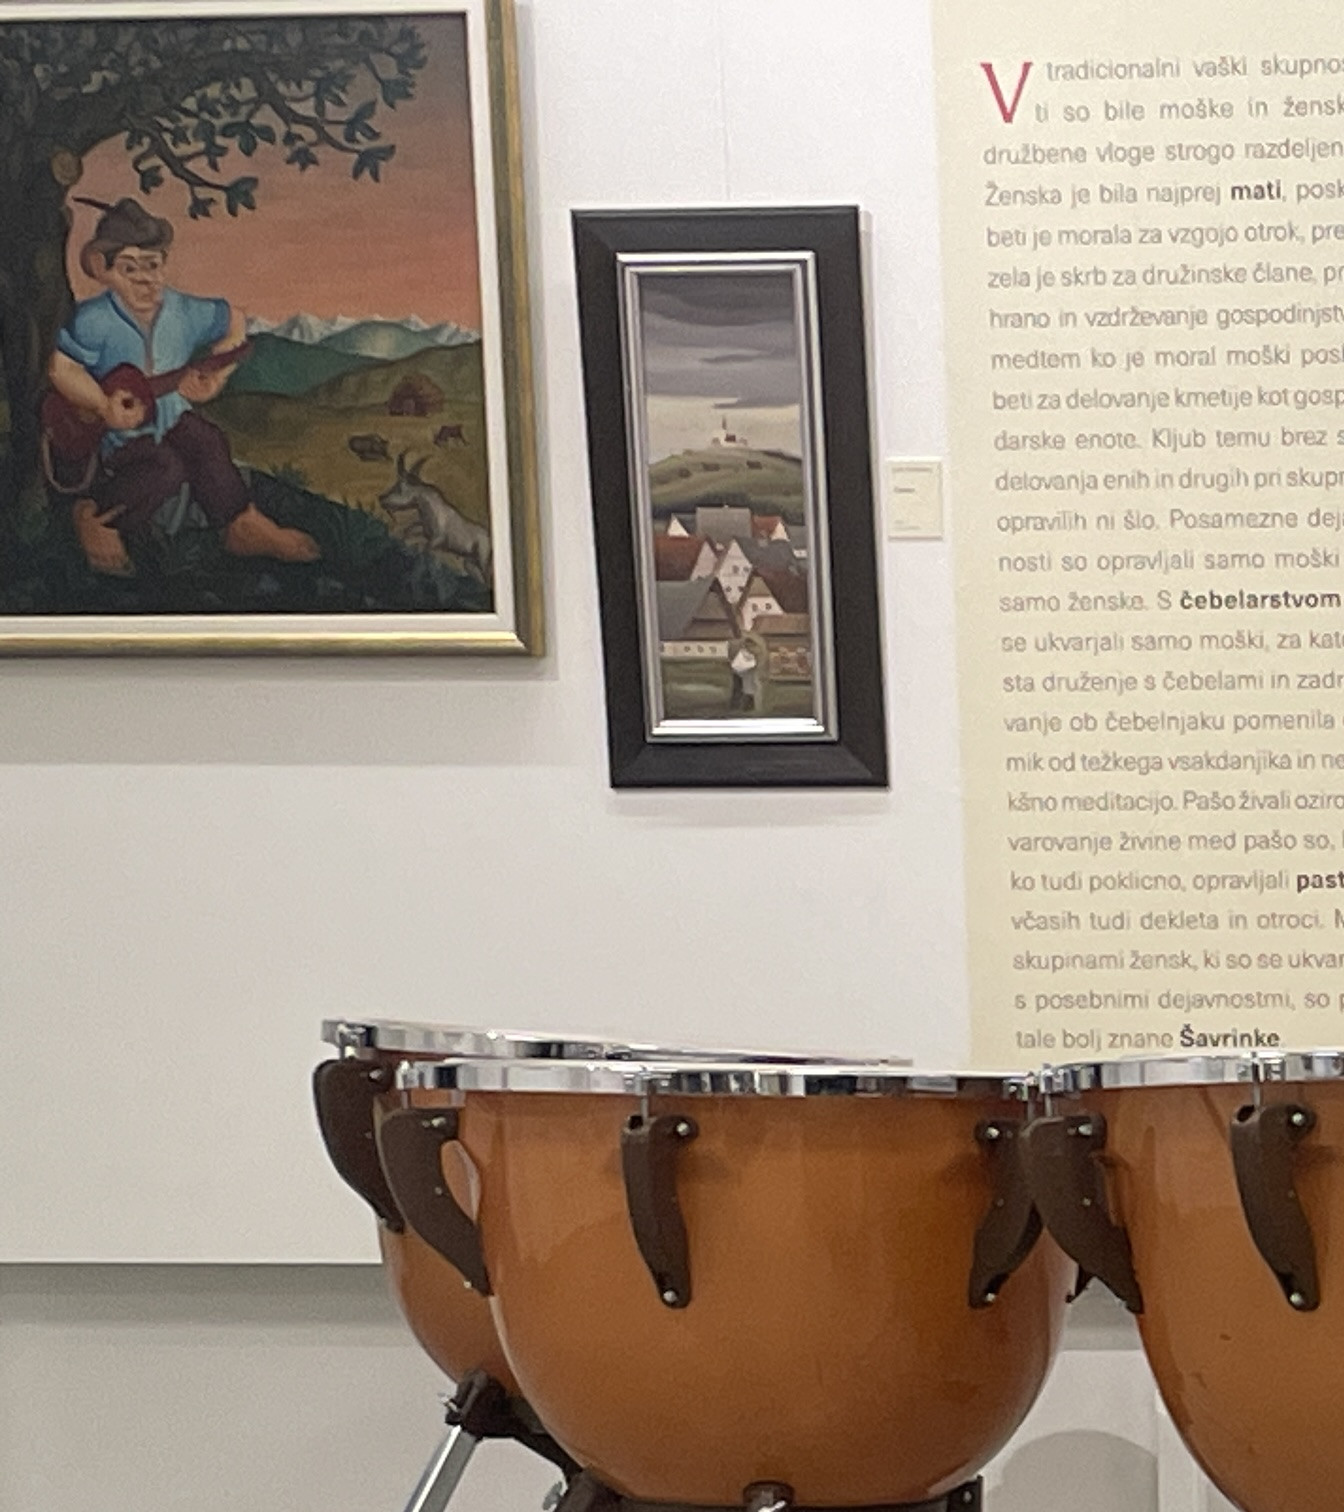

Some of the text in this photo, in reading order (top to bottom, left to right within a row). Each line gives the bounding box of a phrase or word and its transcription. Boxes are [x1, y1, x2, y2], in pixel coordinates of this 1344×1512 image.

[980, 62, 1033, 123] V
[1044, 58, 1180, 81] tradicionalni
[1192, 56, 1249, 78] vaški
[1063, 105, 1090, 122] so
[1104, 99, 1145, 122] bile
[1160, 97, 1234, 120] moške
[1247, 96, 1271, 118] in
[983, 141, 1235, 167] družbene vloge strogo
[985, 180, 1062, 207] Ženska
[1071, 184, 1090, 210] je
[1099, 183, 1138, 204] bila
[1146, 186, 1226, 207] najprej
[1058, 225, 1132, 246] morala
[1136, 227, 1162, 245] za
[1167, 225, 1239, 248] vzgojo
[988, 267, 1030, 289] zela
[1061, 265, 1107, 287] skrb
[1142, 263, 1247, 285] družinske
[989, 310, 1051, 329] hrano
[1058, 309, 1077, 328] in
[1084, 305, 1208, 330] vzdrževanje
[1090, 347, 1117, 369] ko
[1154, 347, 1216, 367] moral
[1226, 343, 1290, 366] moški
[1065, 388, 1170, 412] delovanje
[1174, 387, 1253, 410] kmetije
[1257, 386, 1288, 407] kot
[994, 430, 1066, 451] darske
[1152, 427, 1207, 452] Kljub
[1216, 430, 1271, 448] temu
[1281, 427, 1328, 446] brez
[995, 471, 1098, 494] delovanja
[1103, 470, 1150, 490] enih
[1155, 469, 1174, 489] in
[1178, 467, 1249, 493] drugih
[1169, 508, 1298, 529] Posamezne
[999, 554, 1052, 572] nosti
[1061, 556, 1087, 572] so
[1097, 550, 1194, 575] opravljali
[1204, 553, 1265, 570] samo
[1275, 547, 1339, 569] moški
[999, 596, 1060, 612] samo
[1156, 590, 1173, 610] S
[1179, 589, 1341, 610] čebelarstvom
[1131, 634, 1192, 651] samo
[1277, 633, 1301, 650] za
[1003, 675, 1035, 692] sta
[1042, 670, 1138, 695] druženje
[1162, 671, 1264, 690] čebelami
[1271, 674, 1290, 689] in
[1004, 716, 1062, 736] vanje
[1069, 713, 1098, 732] ob
[1105, 711, 1225, 734] čebelnjaku
[1233, 711, 1335, 732] pomenila
[1006, 752, 1044, 772] mik
[1048, 752, 1076, 772] od
[1080, 751, 1164, 775] težkega
[1167, 750, 1292, 771] vsakdanjika
[1297, 750, 1316, 769] in
[1008, 792, 1058, 812] kšno
[1183, 790, 1236, 810] Pašo
[1239, 790, 1291, 810] živali
[1009, 834, 1111, 856] varovanje
[1188, 832, 1236, 850] med
[1244, 830, 1297, 853] pašo
[1011, 871, 1035, 891] ko
[1041, 871, 1083, 891] tudi
[1192, 870, 1290, 894] opravljali
[1011, 910, 1081, 931] včasih
[1090, 911, 1131, 930] tudi
[1140, 911, 1219, 930] dekleta
[1228, 910, 1248, 930] in
[1202, 950, 1221, 969] ki
[1226, 953, 1252, 970] so
[1035, 992, 1149, 1010] posebnimi
[1304, 992, 1330, 1008] so
[1016, 1029, 1056, 1048] tale
[1062, 1028, 1101, 1051] bolj
